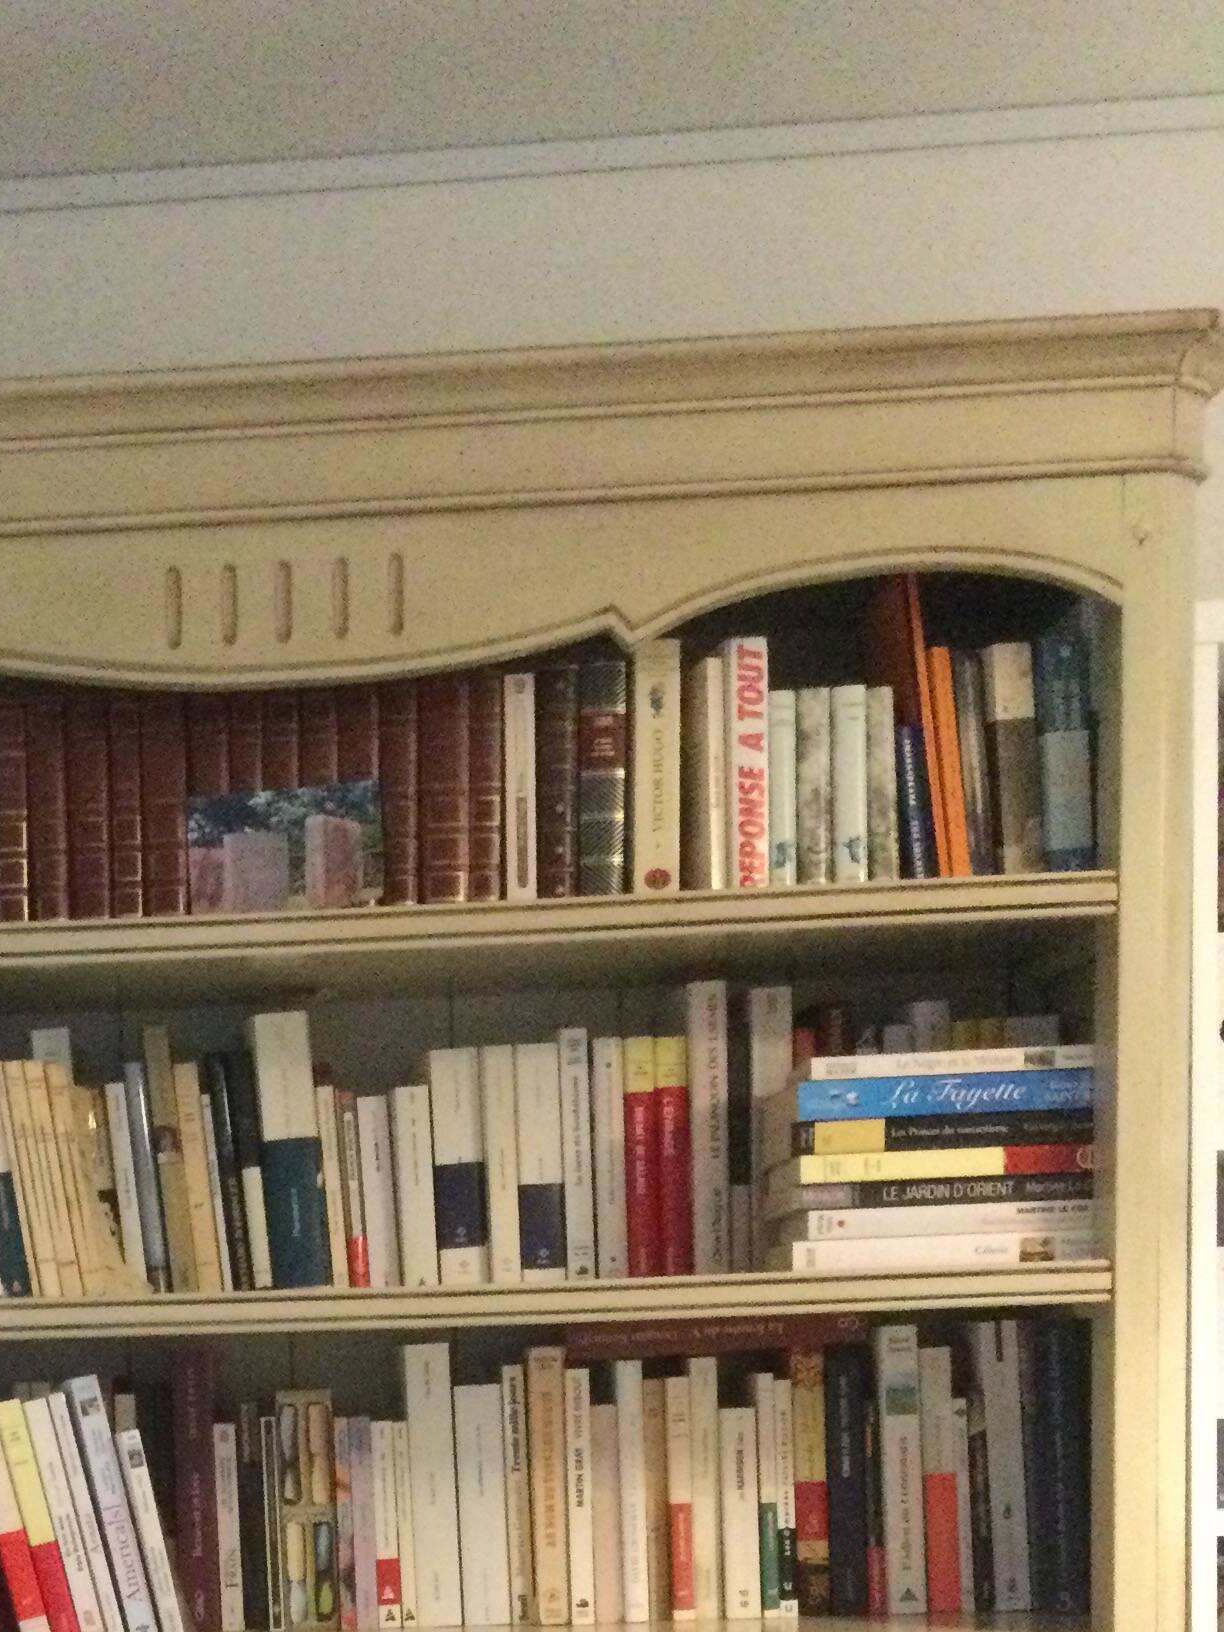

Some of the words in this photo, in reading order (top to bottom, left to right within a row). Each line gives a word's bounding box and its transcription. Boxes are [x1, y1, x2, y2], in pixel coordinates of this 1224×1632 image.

[737, 644, 766, 719] TOUT
[651, 729, 665, 775] HUGO
[743, 732, 765, 753] A
[651, 779, 665, 834] VICTOR
[738, 765, 766, 888] REPONSE
[926, 1078, 1029, 1112] Fayette
[883, 1186, 898, 1201] LE
[903, 1184, 950, 1199] JARDIN
[574, 1447, 584, 1471] GRAY
[575, 1474, 585, 1507] MARTIN
